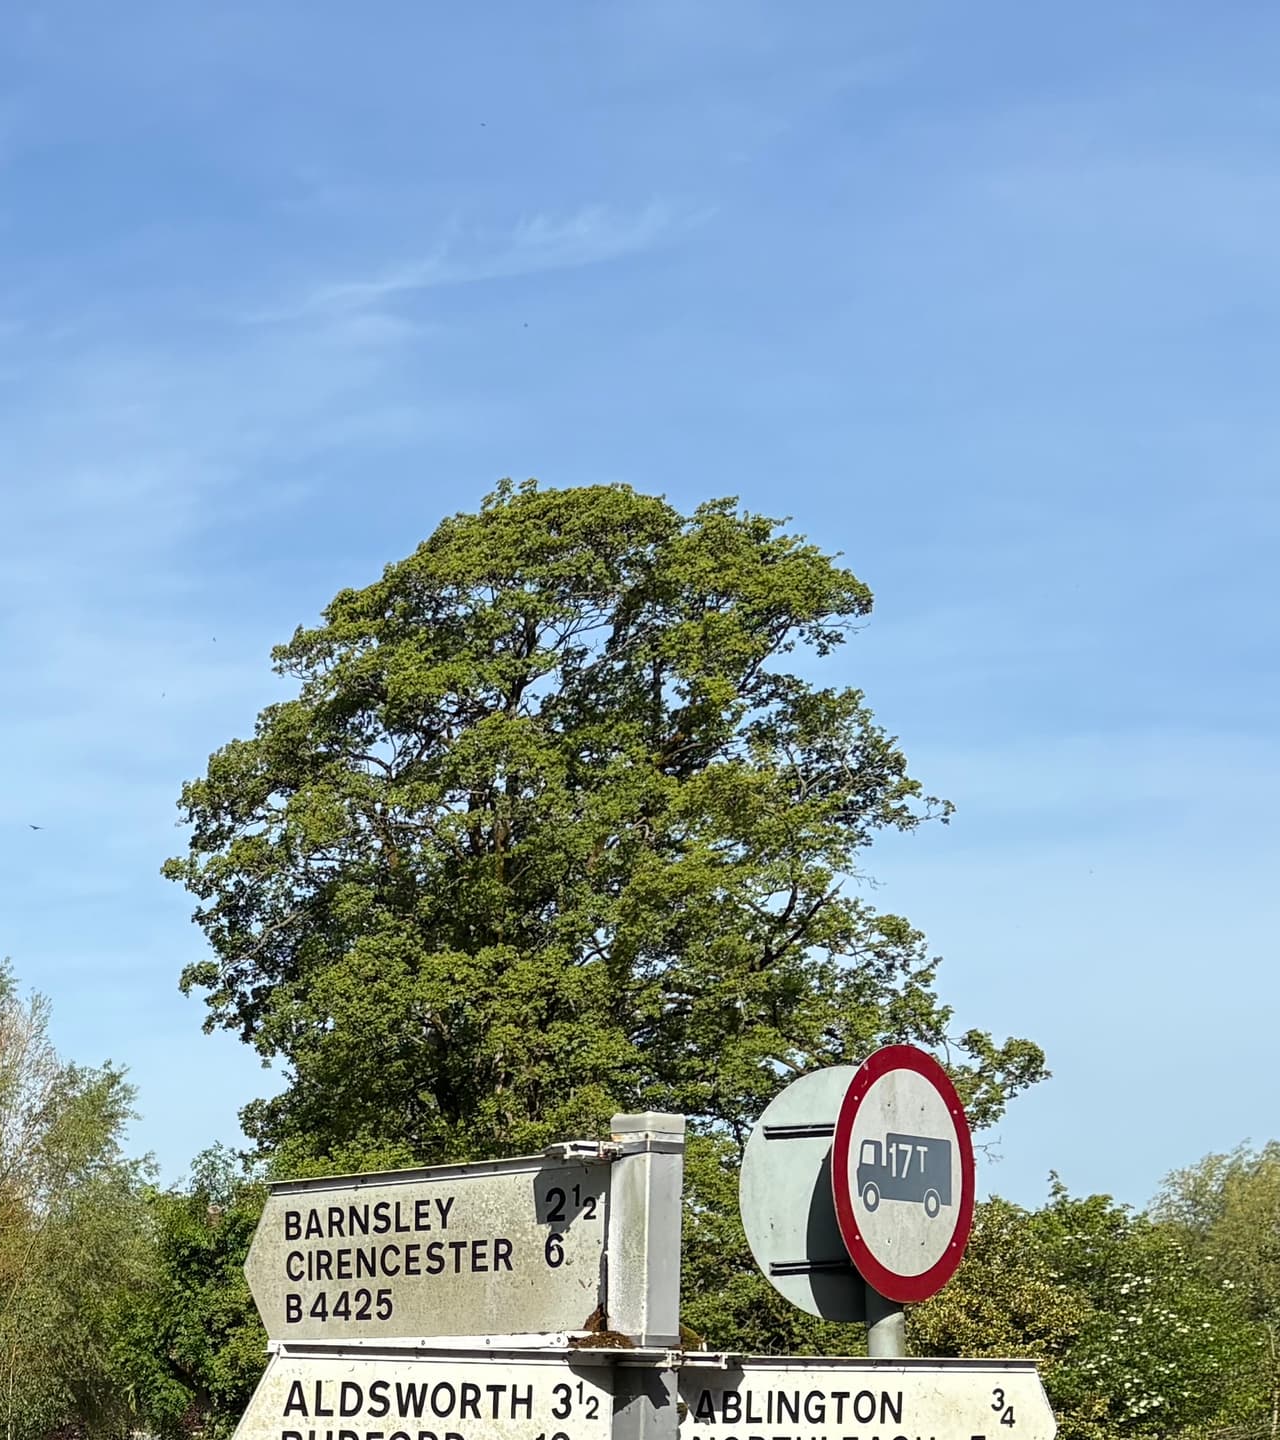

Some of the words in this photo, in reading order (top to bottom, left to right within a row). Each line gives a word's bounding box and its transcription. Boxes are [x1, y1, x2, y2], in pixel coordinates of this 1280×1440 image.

[285, 1198, 454, 1240] BARNSLEY
[286, 1238, 513, 1282] CIRENCESTER
[545, 1233, 564, 1268] 6
[283, 1380, 532, 1419] ALDSWORTH
[693, 1389, 903, 1425] ABLINGTON
